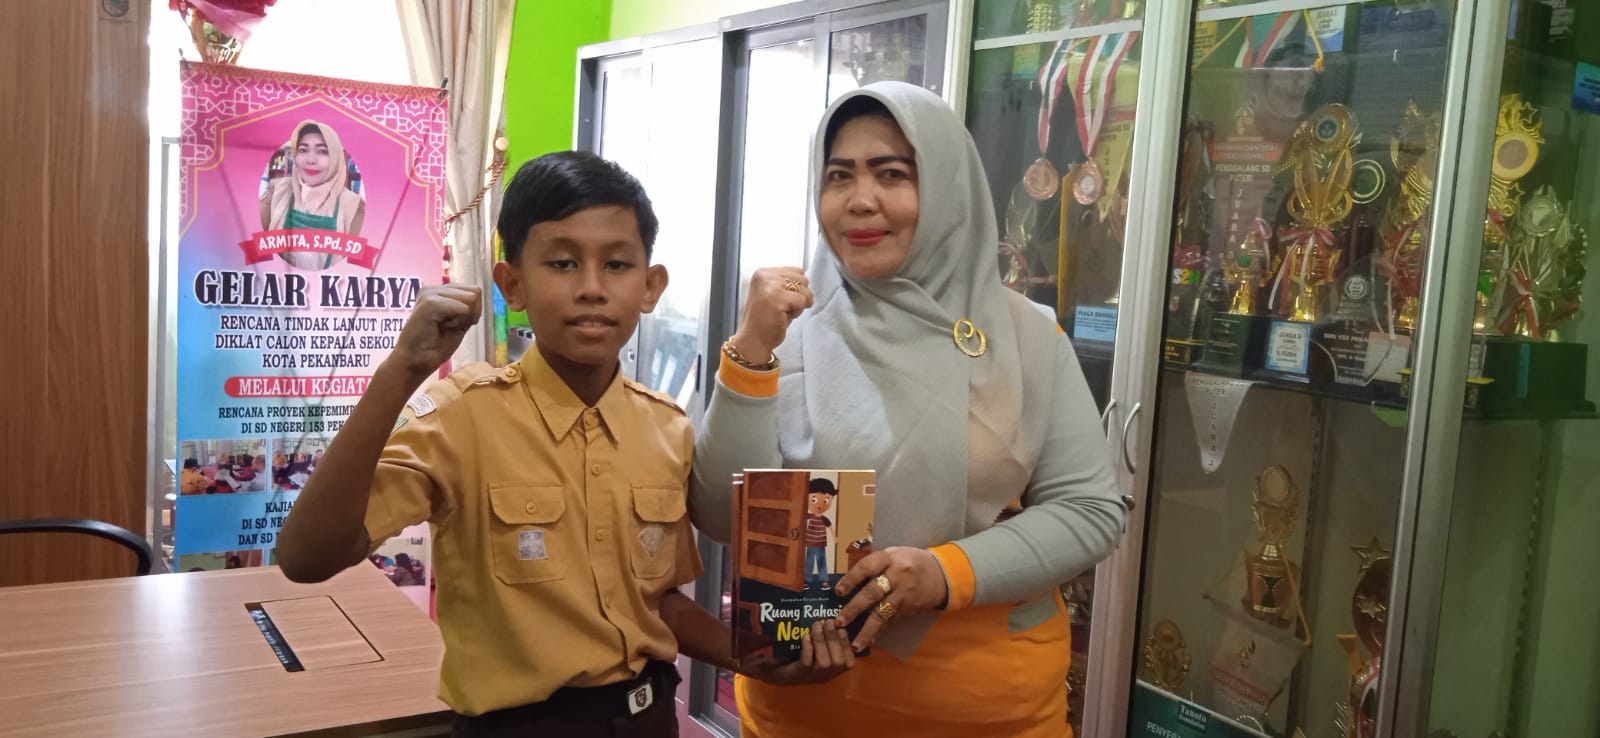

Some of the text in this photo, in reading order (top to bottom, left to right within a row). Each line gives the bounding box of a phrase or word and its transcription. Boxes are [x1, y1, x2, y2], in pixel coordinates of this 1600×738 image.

[258, 234, 362, 254] ARMITA, S.Pd. SD
[195, 271, 421, 309] GELAR KARYA
[221, 315, 281, 331] RENCANA
[284, 316, 330, 331] TINDAK
[333, 317, 377, 332] LANJUT
[215, 334, 395, 350] DIKLAT CALON KEPALA SEKOL
[262, 353, 371, 368] KOTA PEKANBARU
[238, 378, 307, 396] MELALUI
[218, 405, 355, 419] RENCANA PROYEK KEPEMIMP
[241, 420, 345, 434] DI SD NEGERI 153 PEK
[265, 501, 295, 513] KAJIA
[242, 518, 253, 530] DI
[255, 517, 268, 529] SD
[238, 533, 259, 546] DAN
[260, 532, 273, 544] SD
[760, 602, 843, 623] Ruang Rahasi
[777, 621, 810, 642] Nen
